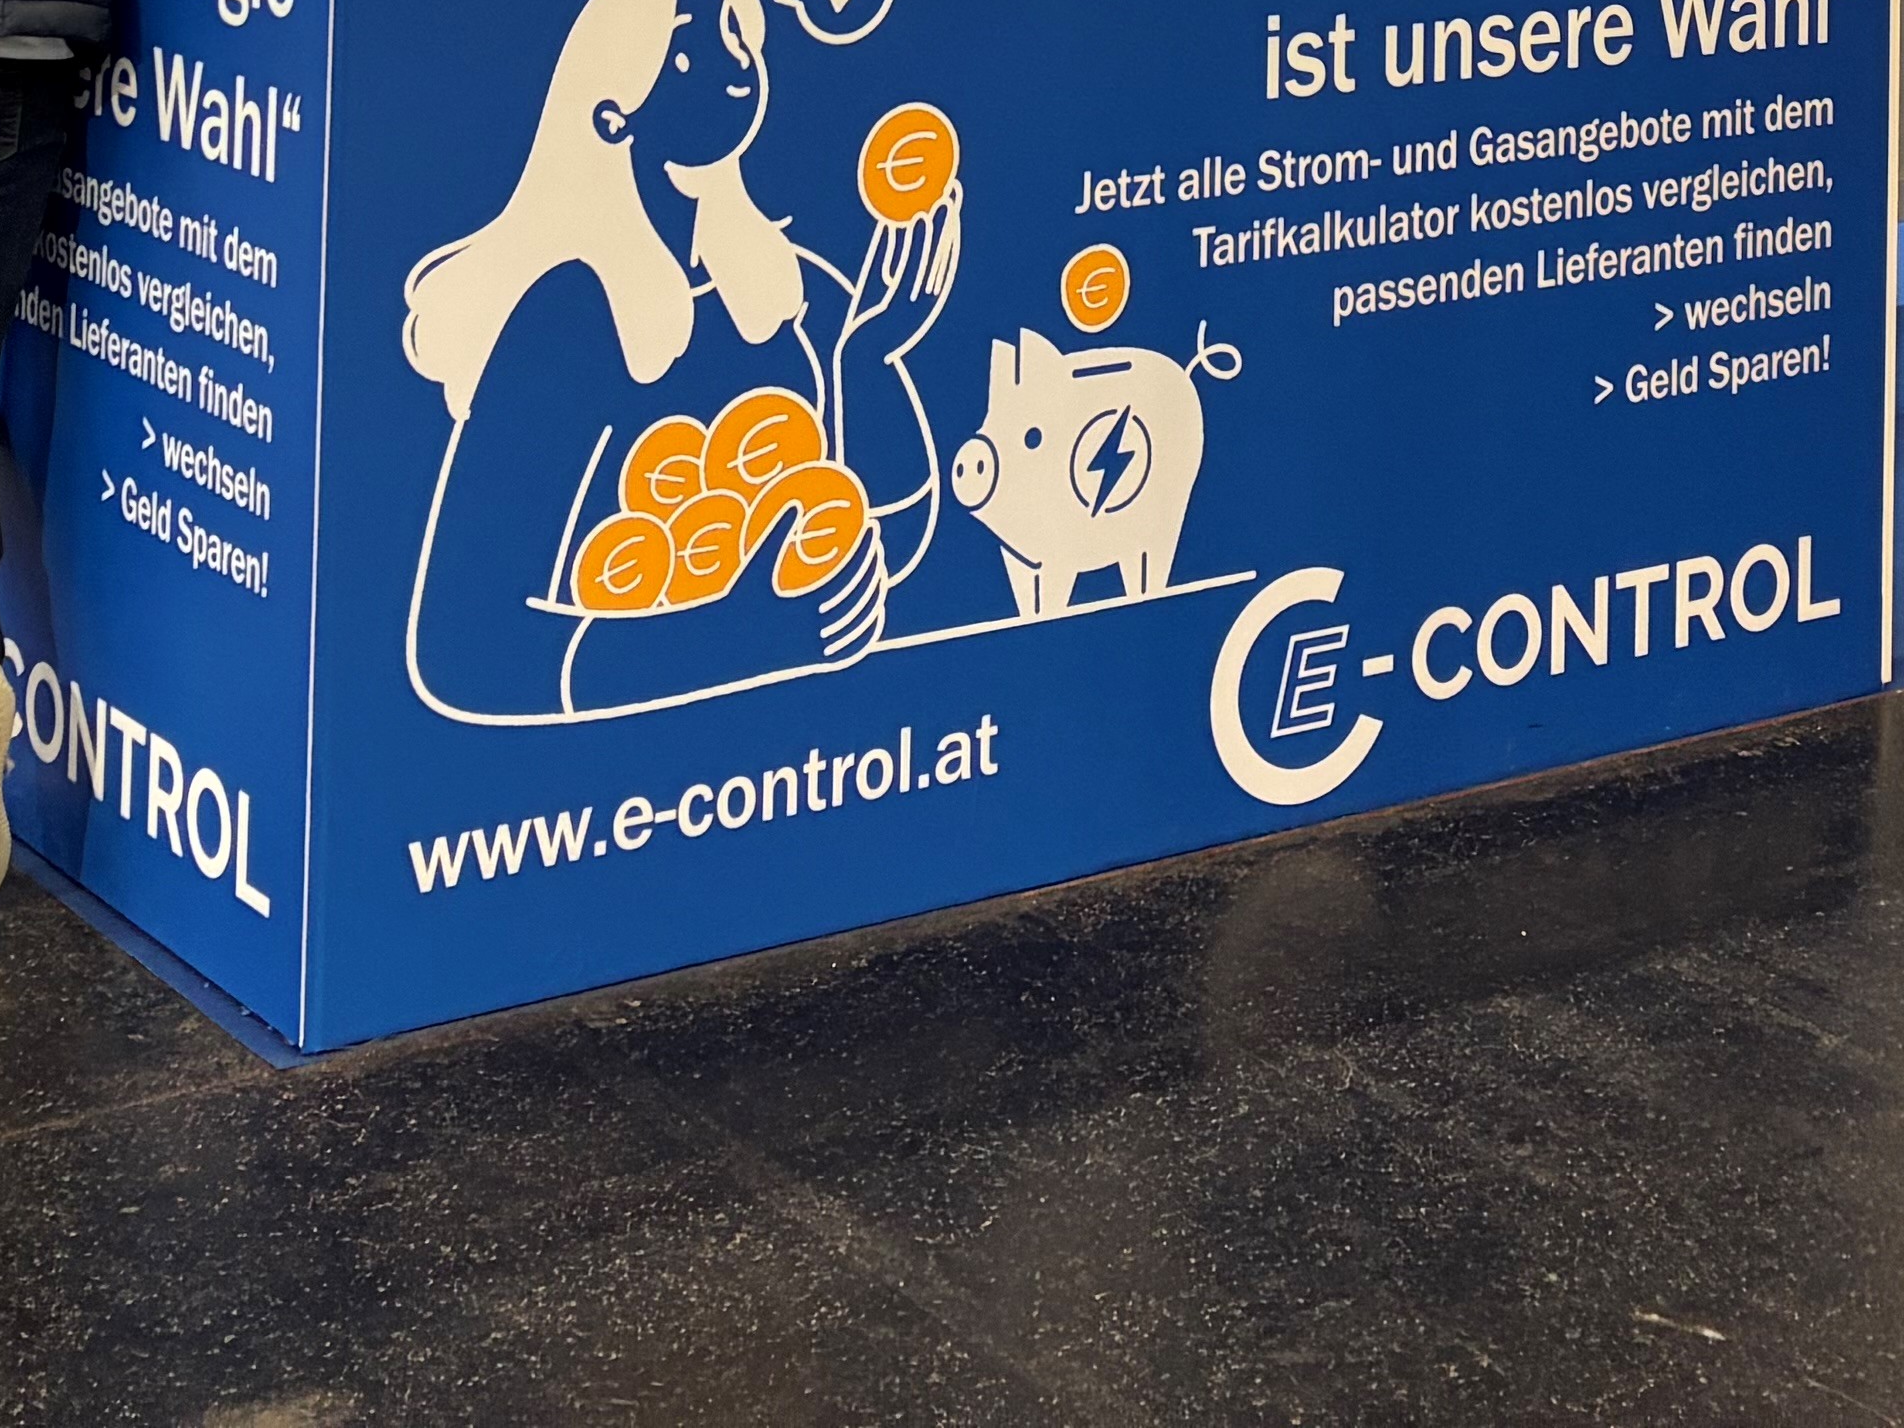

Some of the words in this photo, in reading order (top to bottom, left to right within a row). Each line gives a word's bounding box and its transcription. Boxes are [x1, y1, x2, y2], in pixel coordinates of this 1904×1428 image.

[1266, 13, 1355, 99] ist
[1385, 4, 1633, 87] unsere
[1075, 165, 1165, 214] Jetzt
[1178, 156, 1246, 201] alle
[1257, 149, 1382, 191] Strom-
[1393, 130, 1457, 175] und
[1469, 109, 1691, 166] Gasangebote
[1703, 99, 1755, 139] mit
[1765, 94, 1833, 132] dem
[179, 214, 218, 263] mit
[224, 226, 277, 288] dem
[1192, 202, 1459, 268] Tarifkalkulator
[1471, 179, 1633, 232] kostenlos
[1642, 157, 1833, 212] vergleichen,
[138, 272, 274, 373] vergleichen,
[1334, 258, 1524, 327] passenden
[1537, 234, 1723, 288] Lieferanten
[1734, 216, 1831, 260] finden
[1684, 276, 1831, 330] wechseln
[71, 303, 192, 402] Lieferanten
[198, 366, 272, 443] finden
[1625, 356, 1698, 403] Geld
[1708, 334, 1830, 394] Sparen!
[162, 433, 270, 520] wechseln
[121, 477, 172, 543] Geld
[177, 507, 268, 598] Sparen!
[408, 714, 998, 893] www.e-control.at
